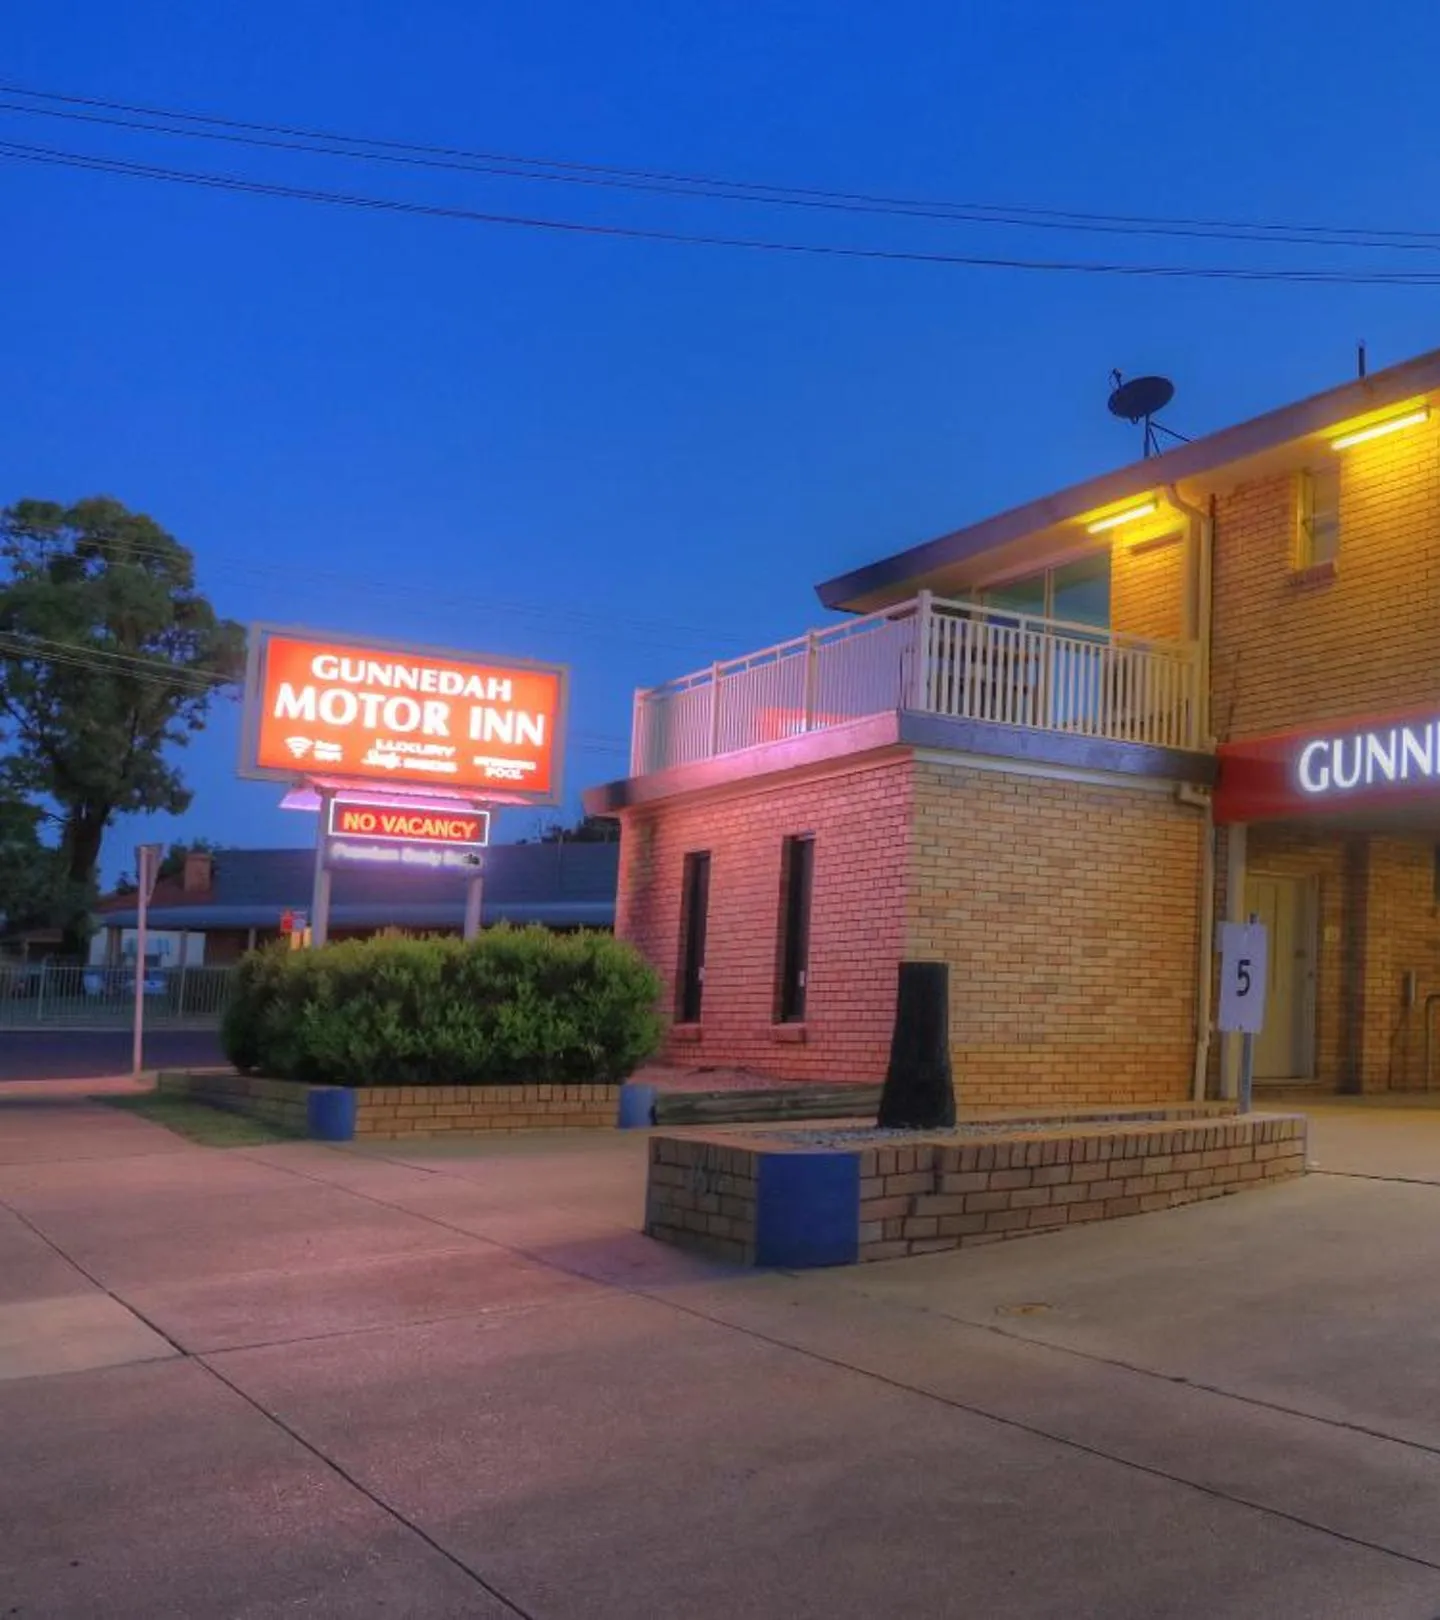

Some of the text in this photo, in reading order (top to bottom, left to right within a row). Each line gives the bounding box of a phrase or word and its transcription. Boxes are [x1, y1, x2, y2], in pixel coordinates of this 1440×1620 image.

[311, 655, 513, 702] GUNNEDAH
[274, 683, 545, 746] MOTOR INN
[343, 811, 477, 838] NO VACANCY
[1236, 959, 1251, 997] 5
